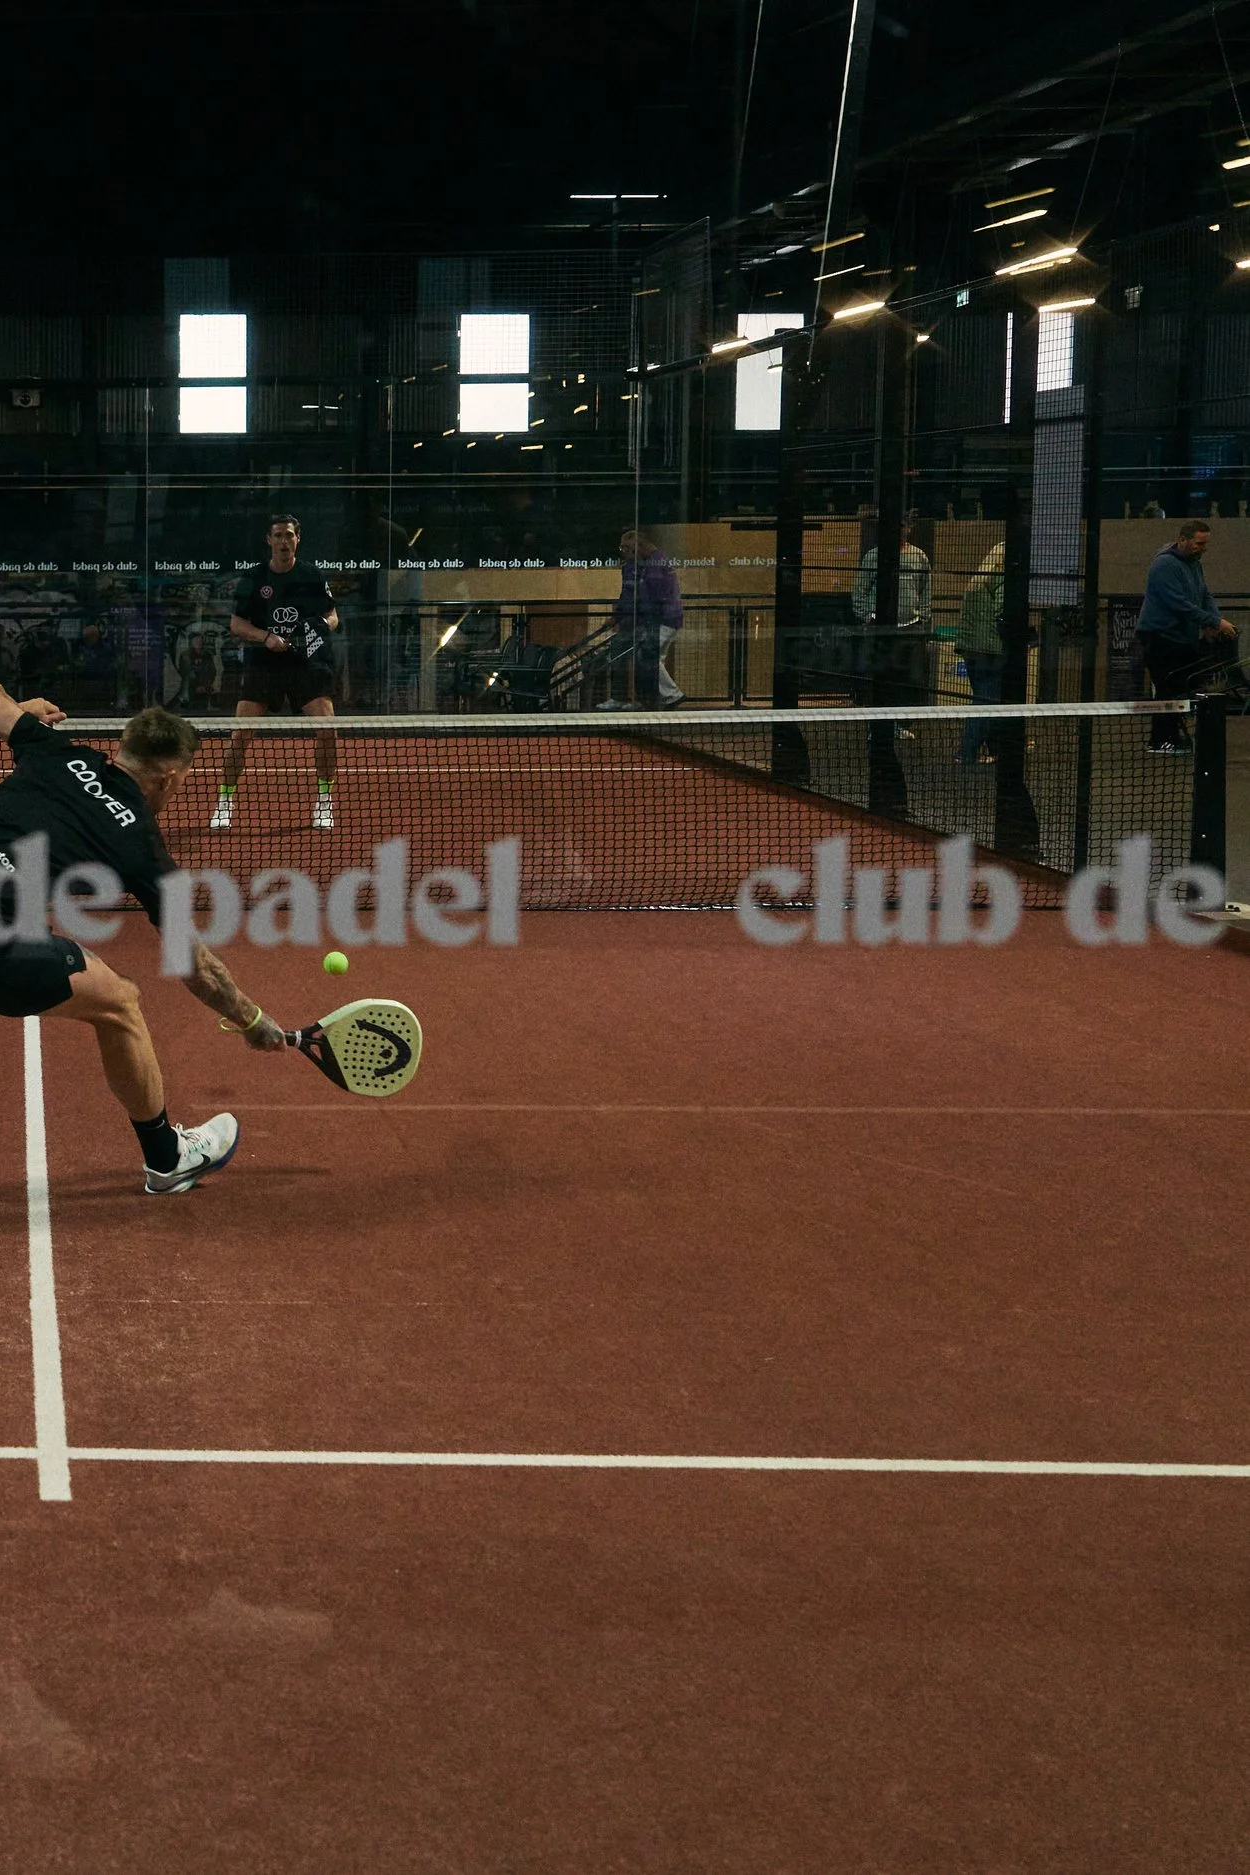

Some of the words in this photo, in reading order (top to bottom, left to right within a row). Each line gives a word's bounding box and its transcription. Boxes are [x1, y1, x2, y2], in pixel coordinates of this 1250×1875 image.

[729, 557, 750, 566] club
[159, 834, 521, 977] padel
[735, 834, 1022, 946] club
[1063, 834, 1229, 946] de
